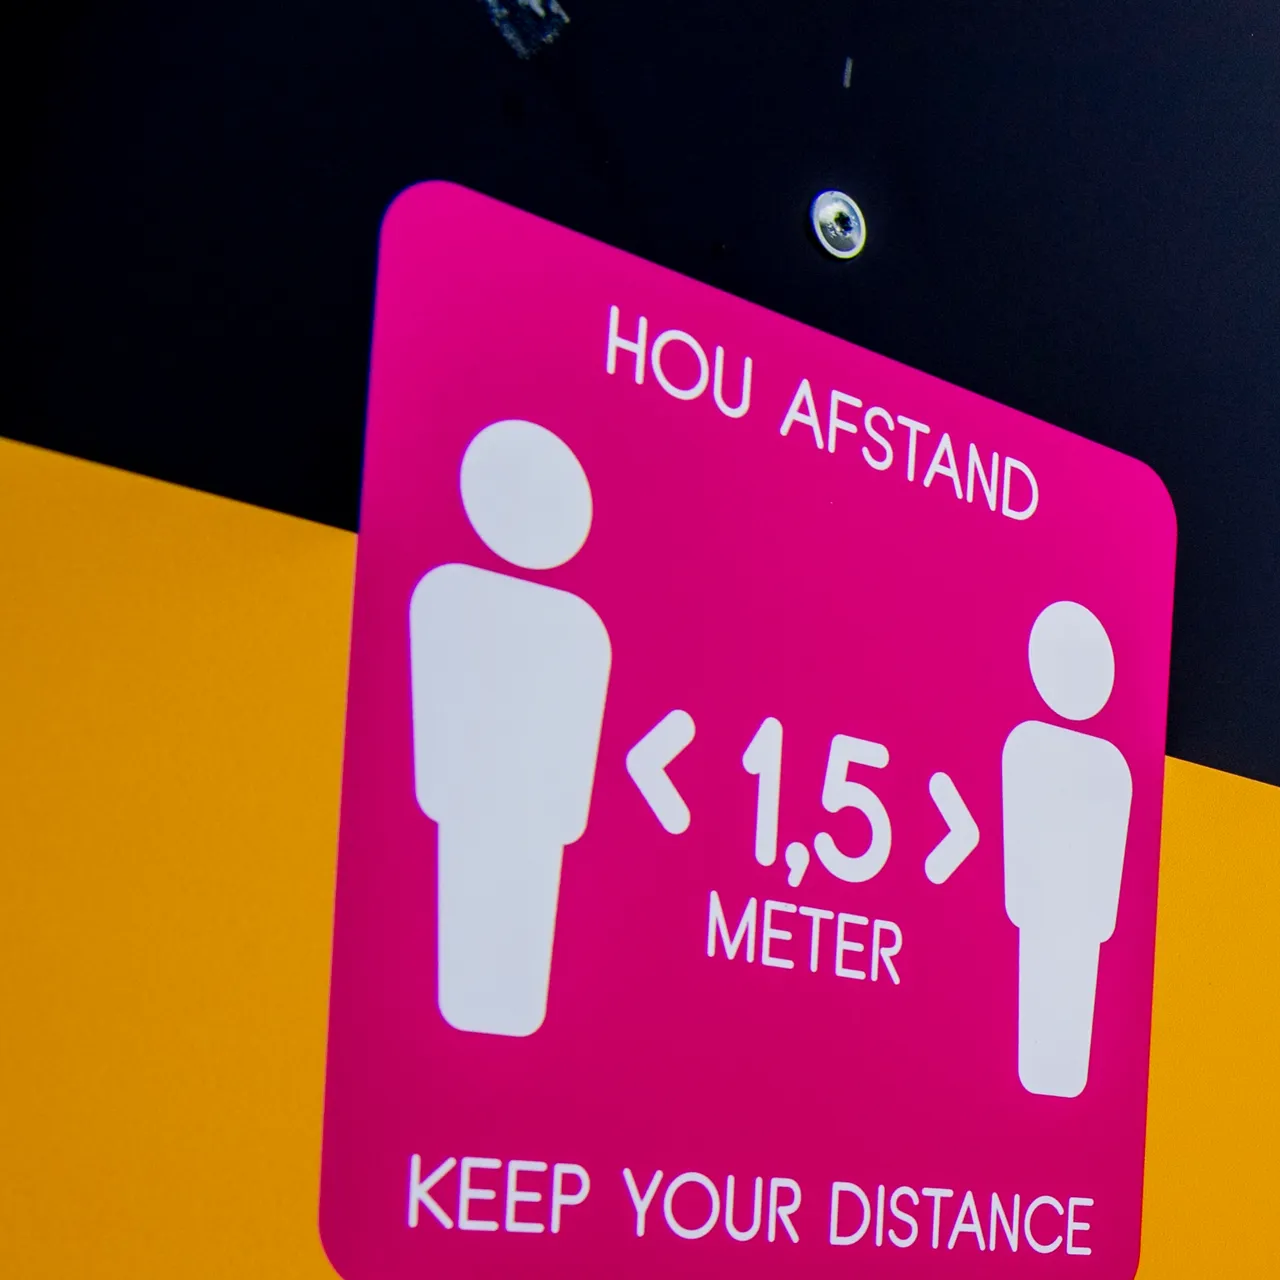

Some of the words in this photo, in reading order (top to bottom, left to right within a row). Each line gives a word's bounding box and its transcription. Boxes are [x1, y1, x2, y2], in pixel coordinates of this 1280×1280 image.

[606, 305, 753, 418] HOU
[780, 379, 1039, 521] AFSTAND
[742, 717, 892, 887] 1,5
[707, 890, 903, 985] METER
[407, 1154, 591, 1233] KEEP
[622, 1167, 802, 1243] YOUR
[829, 1181, 1094, 1256] DISTANCE
